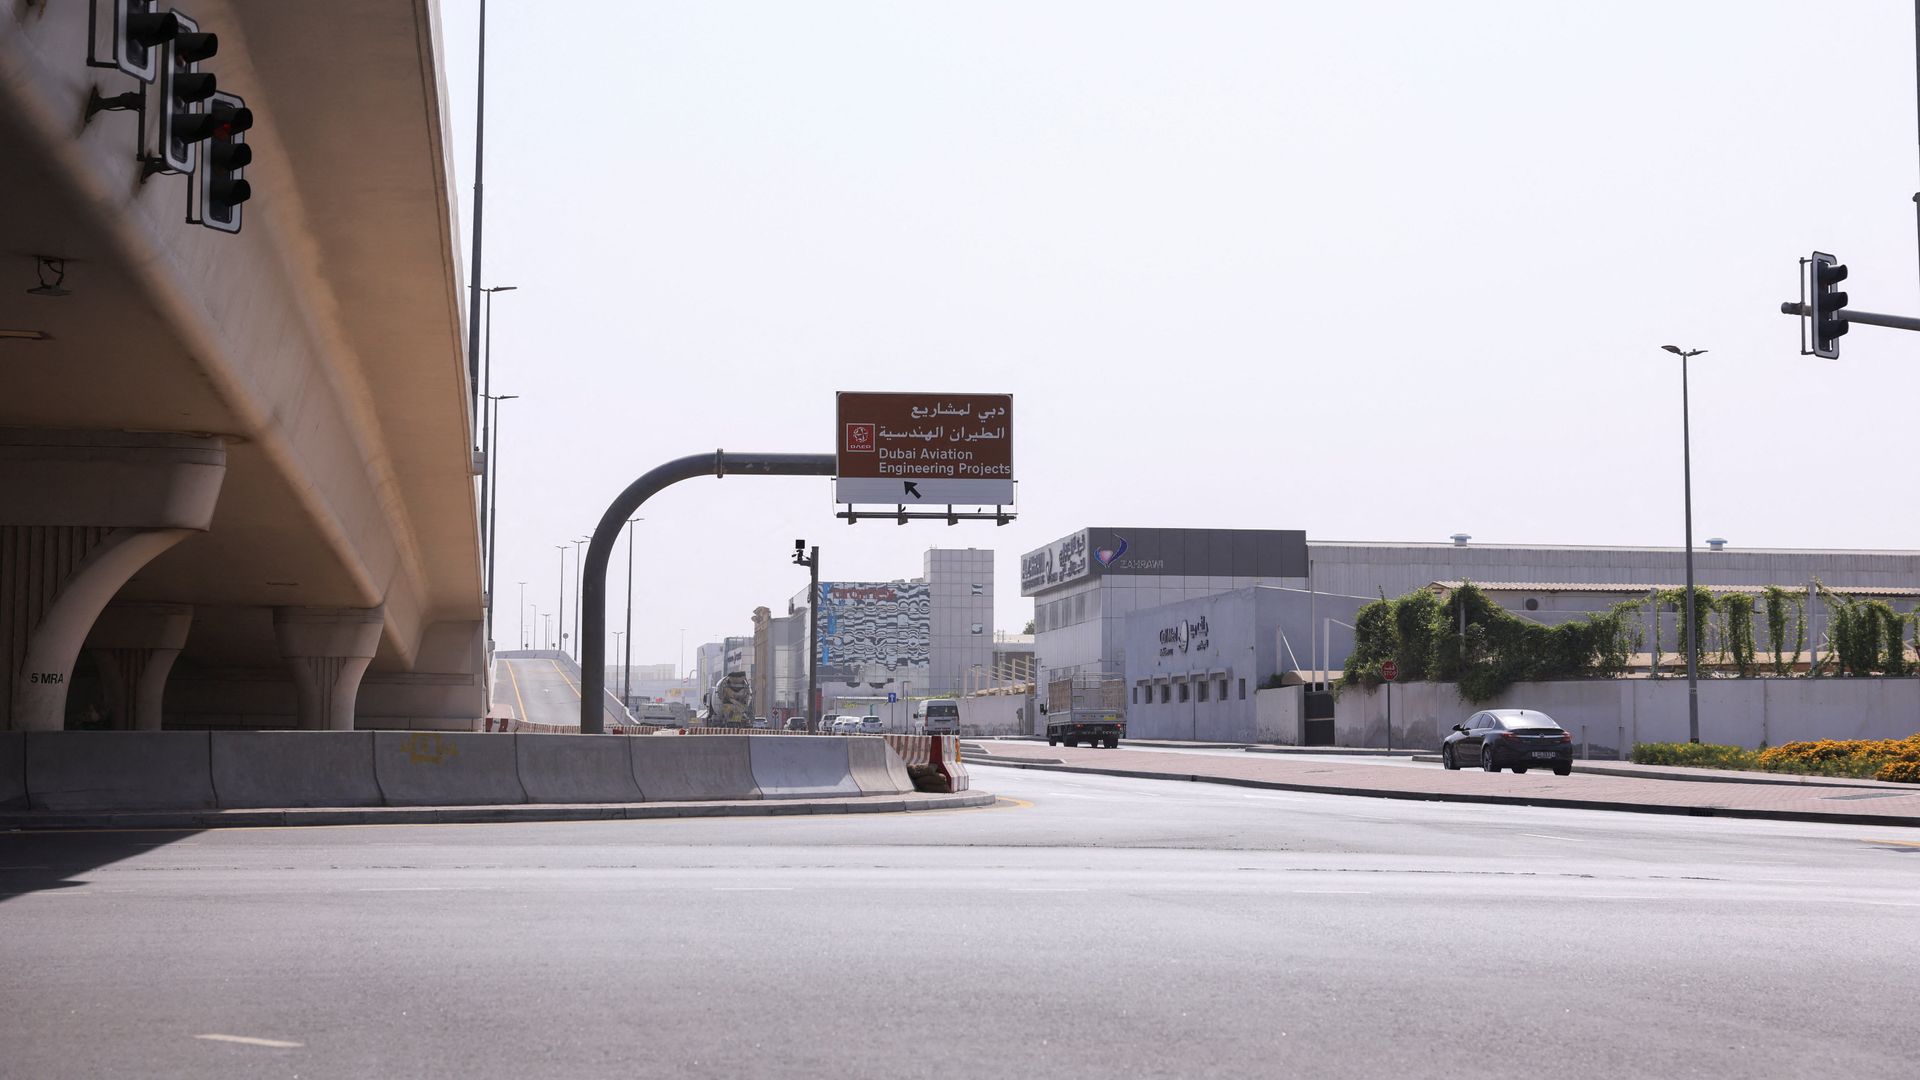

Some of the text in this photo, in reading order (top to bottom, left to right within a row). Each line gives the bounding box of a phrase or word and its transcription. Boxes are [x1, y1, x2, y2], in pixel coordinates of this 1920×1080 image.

[911, 402, 1005, 422] دبي لمشاريع
[879, 426, 1005, 442] الطيران الهندسية
[879, 448, 973, 460] Dubai Aviation
[879, 462, 1011, 477] Engineering Projects
[1119, 559, 1164, 569] ZAHRAWI
[30, 672, 64, 684] 5 MRA
